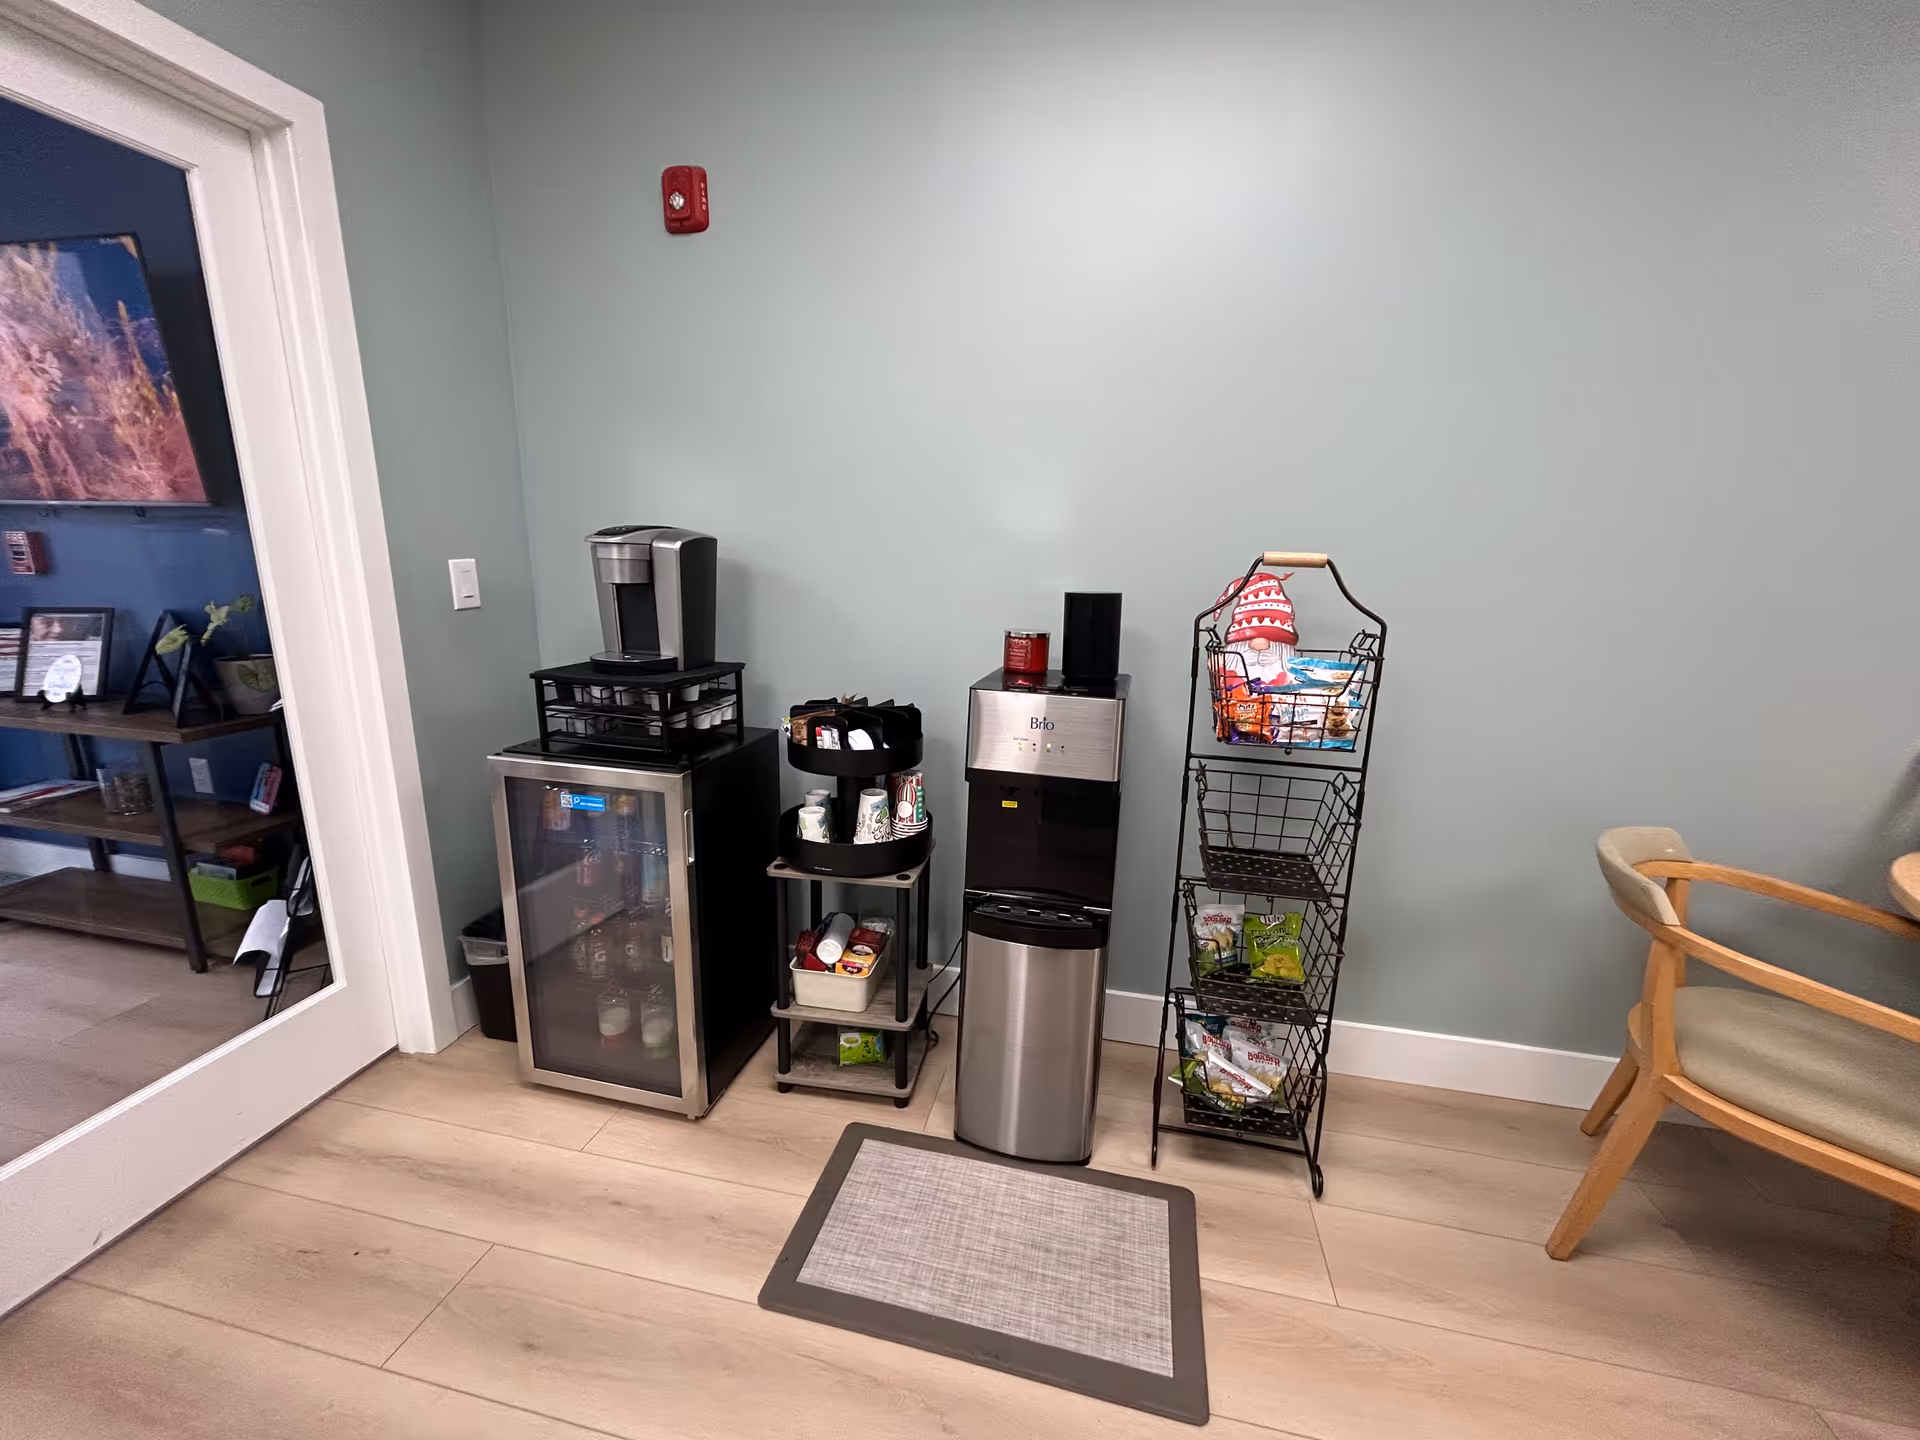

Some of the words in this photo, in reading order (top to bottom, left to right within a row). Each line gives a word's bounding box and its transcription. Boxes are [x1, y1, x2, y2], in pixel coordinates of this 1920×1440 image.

[5, 532, 25, 541] FIRE
[1030, 716, 1055, 731] Brio
[1247, 1051, 1280, 1067] BOULDER
